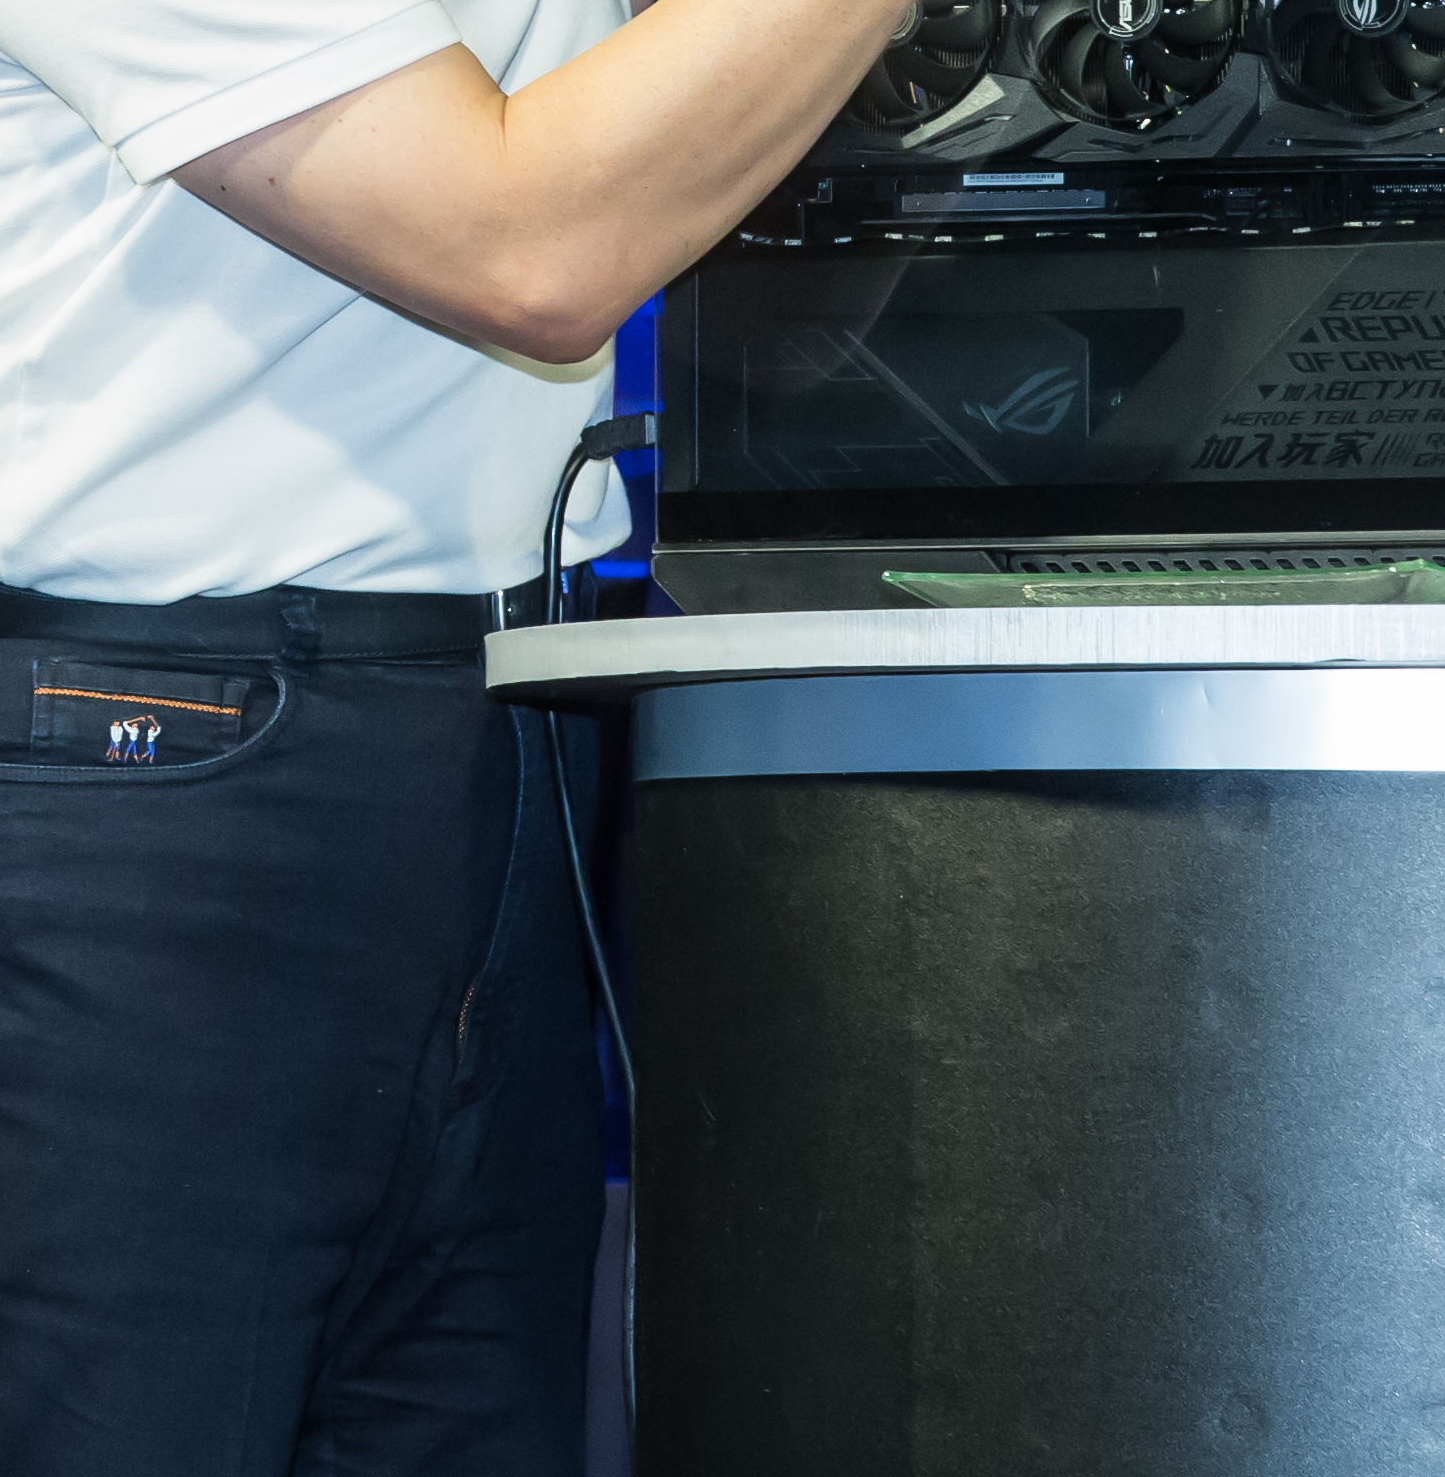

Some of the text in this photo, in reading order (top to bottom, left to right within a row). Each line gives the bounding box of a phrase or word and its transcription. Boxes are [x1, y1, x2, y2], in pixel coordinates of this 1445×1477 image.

[1287, 352, 1334, 372] OF
[1312, 410, 1359, 424] TEIL
[1367, 409, 1420, 424] DER
[1190, 430, 1376, 469] 加入玩家
